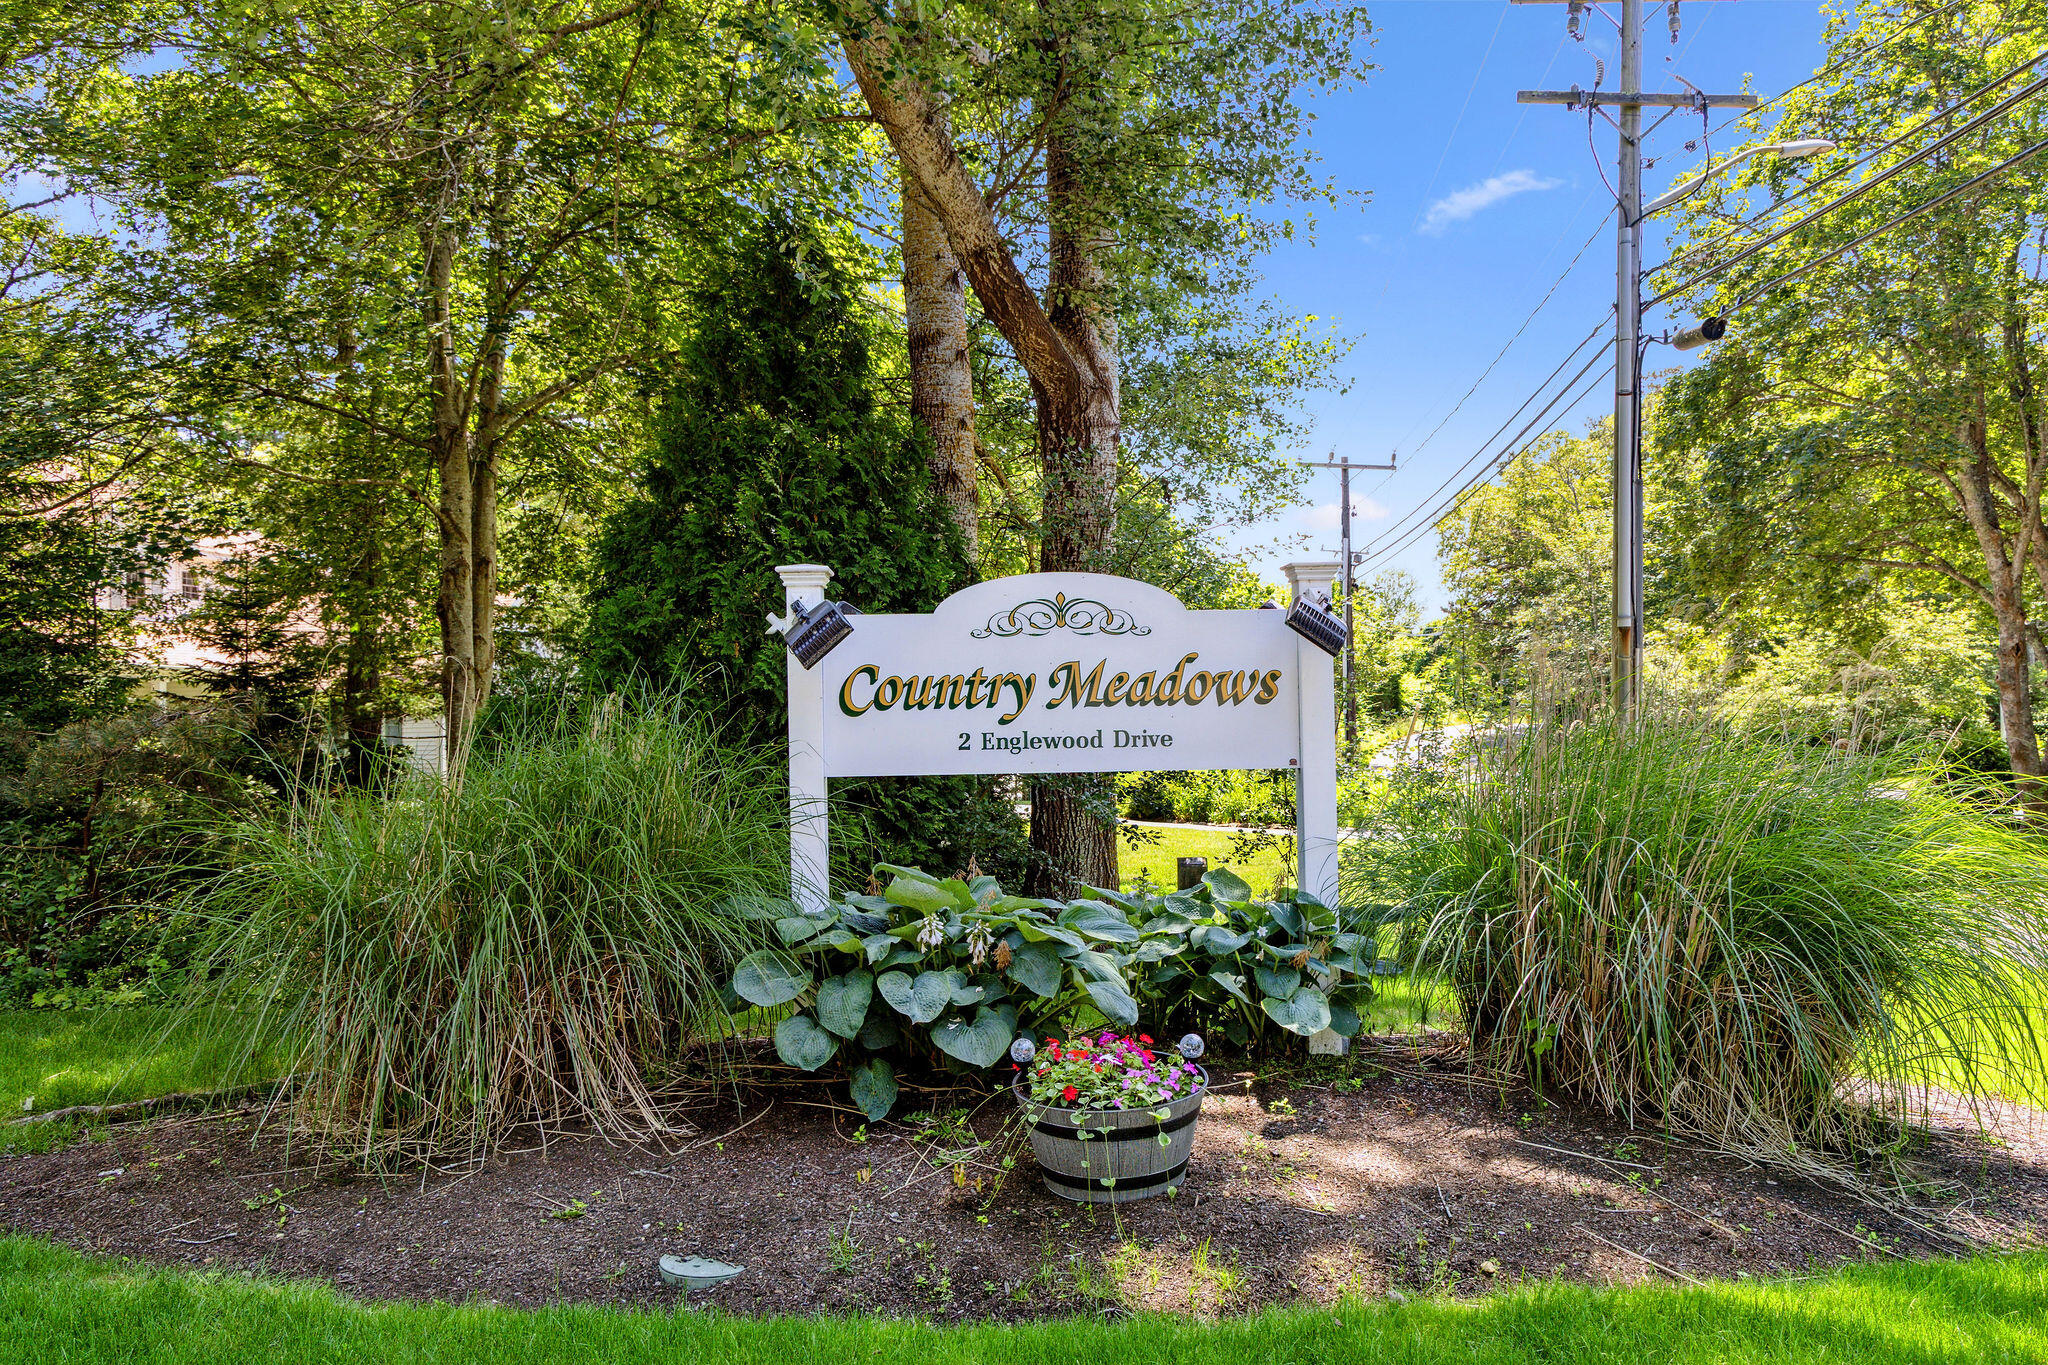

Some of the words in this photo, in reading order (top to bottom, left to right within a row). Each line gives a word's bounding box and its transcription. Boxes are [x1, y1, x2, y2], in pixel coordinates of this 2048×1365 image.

[839, 664, 1037, 725] Country
[1046, 652, 1282, 710] Meadows
[958, 733, 971, 751] 2
[981, 730, 1103, 754] Englewood
[1113, 729, 1174, 749] Drive
